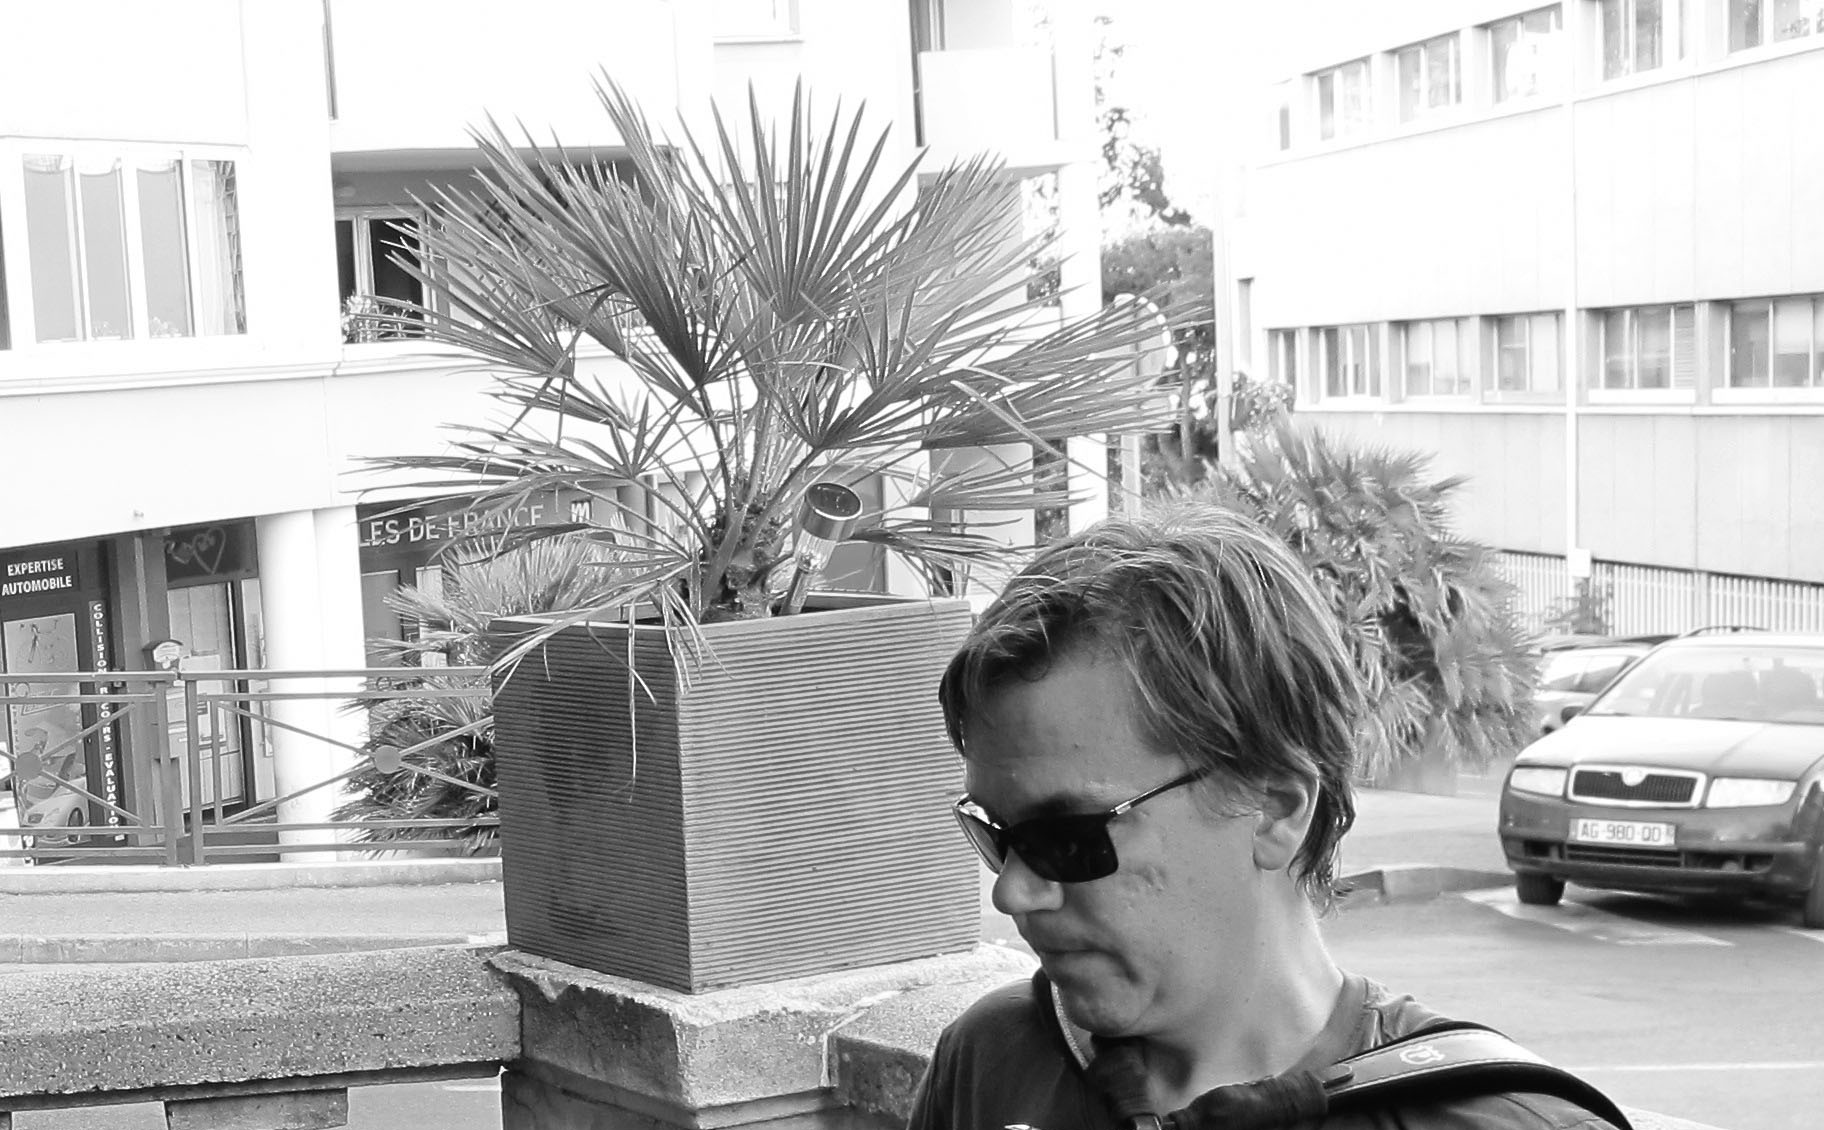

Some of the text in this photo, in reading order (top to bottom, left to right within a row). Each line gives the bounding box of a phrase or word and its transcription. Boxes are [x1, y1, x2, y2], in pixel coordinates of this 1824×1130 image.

[409, 515, 440, 542] DE
[7, 558, 64, 577] EXPERTISE
[1, 575, 73, 597] AUTOMOBILE
[93, 603, 108, 674] COLLISION
[99, 686, 112, 743] RCORS
